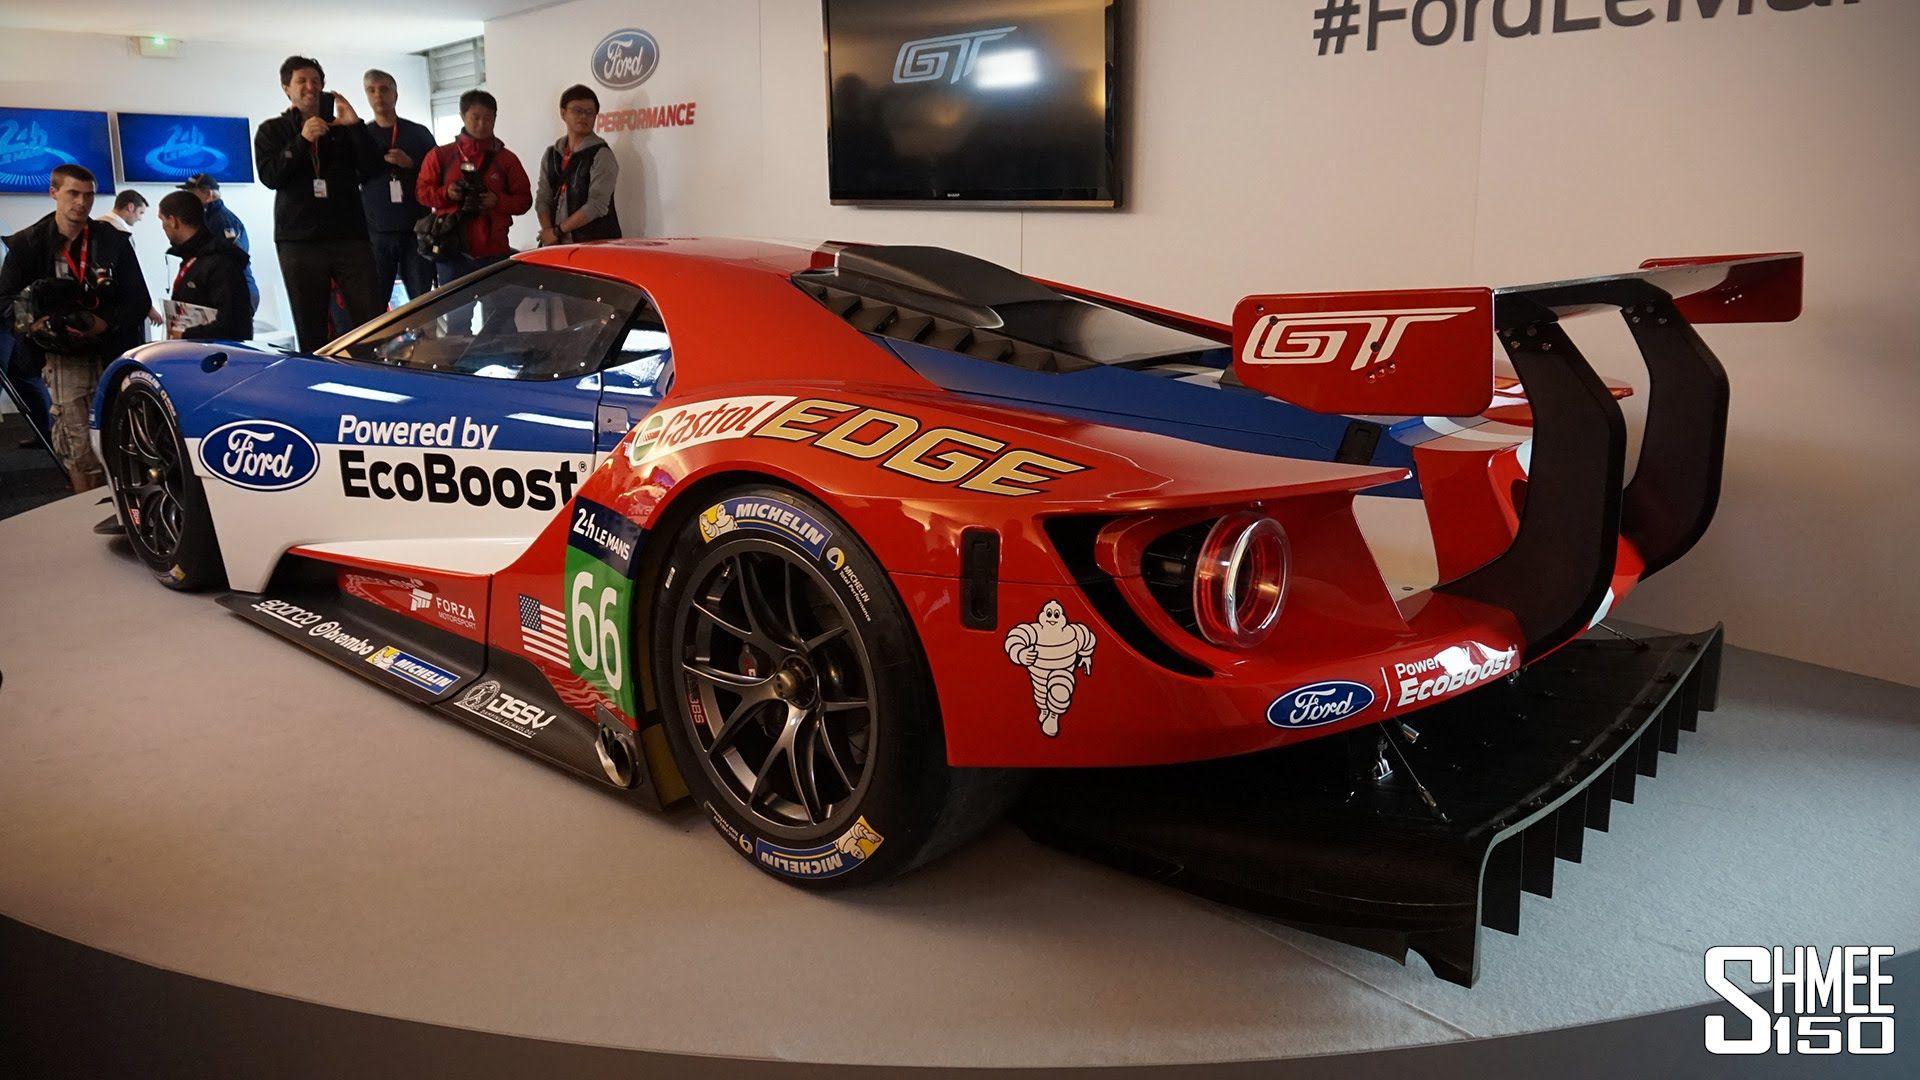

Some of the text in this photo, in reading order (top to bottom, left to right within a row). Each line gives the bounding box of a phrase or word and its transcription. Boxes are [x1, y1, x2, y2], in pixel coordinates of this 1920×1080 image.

[1313, 0, 1860, 55] #FordLe
[603, 39, 644, 80] Ford
[892, 26, 1018, 84] GT
[596, 102, 697, 133] PERFORMANCE
[1242, 306, 1477, 371] GT
[338, 415, 499, 450] Powered by
[656, 398, 1094, 497] Castrol EDGE
[222, 428, 294, 479] Ford
[735, 503, 824, 546] MICHELIN
[594, 526, 606, 546] LE
[605, 533, 631, 561] MANS
[843, 565, 870, 603] MICHELIN
[255, 600, 322, 625] sparco
[435, 597, 475, 621] FORZA
[438, 611, 477, 630] MOTORSPORT
[322, 627, 375, 656] brembo
[571, 571, 622, 691] 66
[394, 658, 453, 688] MICHELIN
[1395, 648, 1454, 679] Power
[1289, 688, 1354, 724] Ford
[761, 851, 844, 875] MICHELIN
